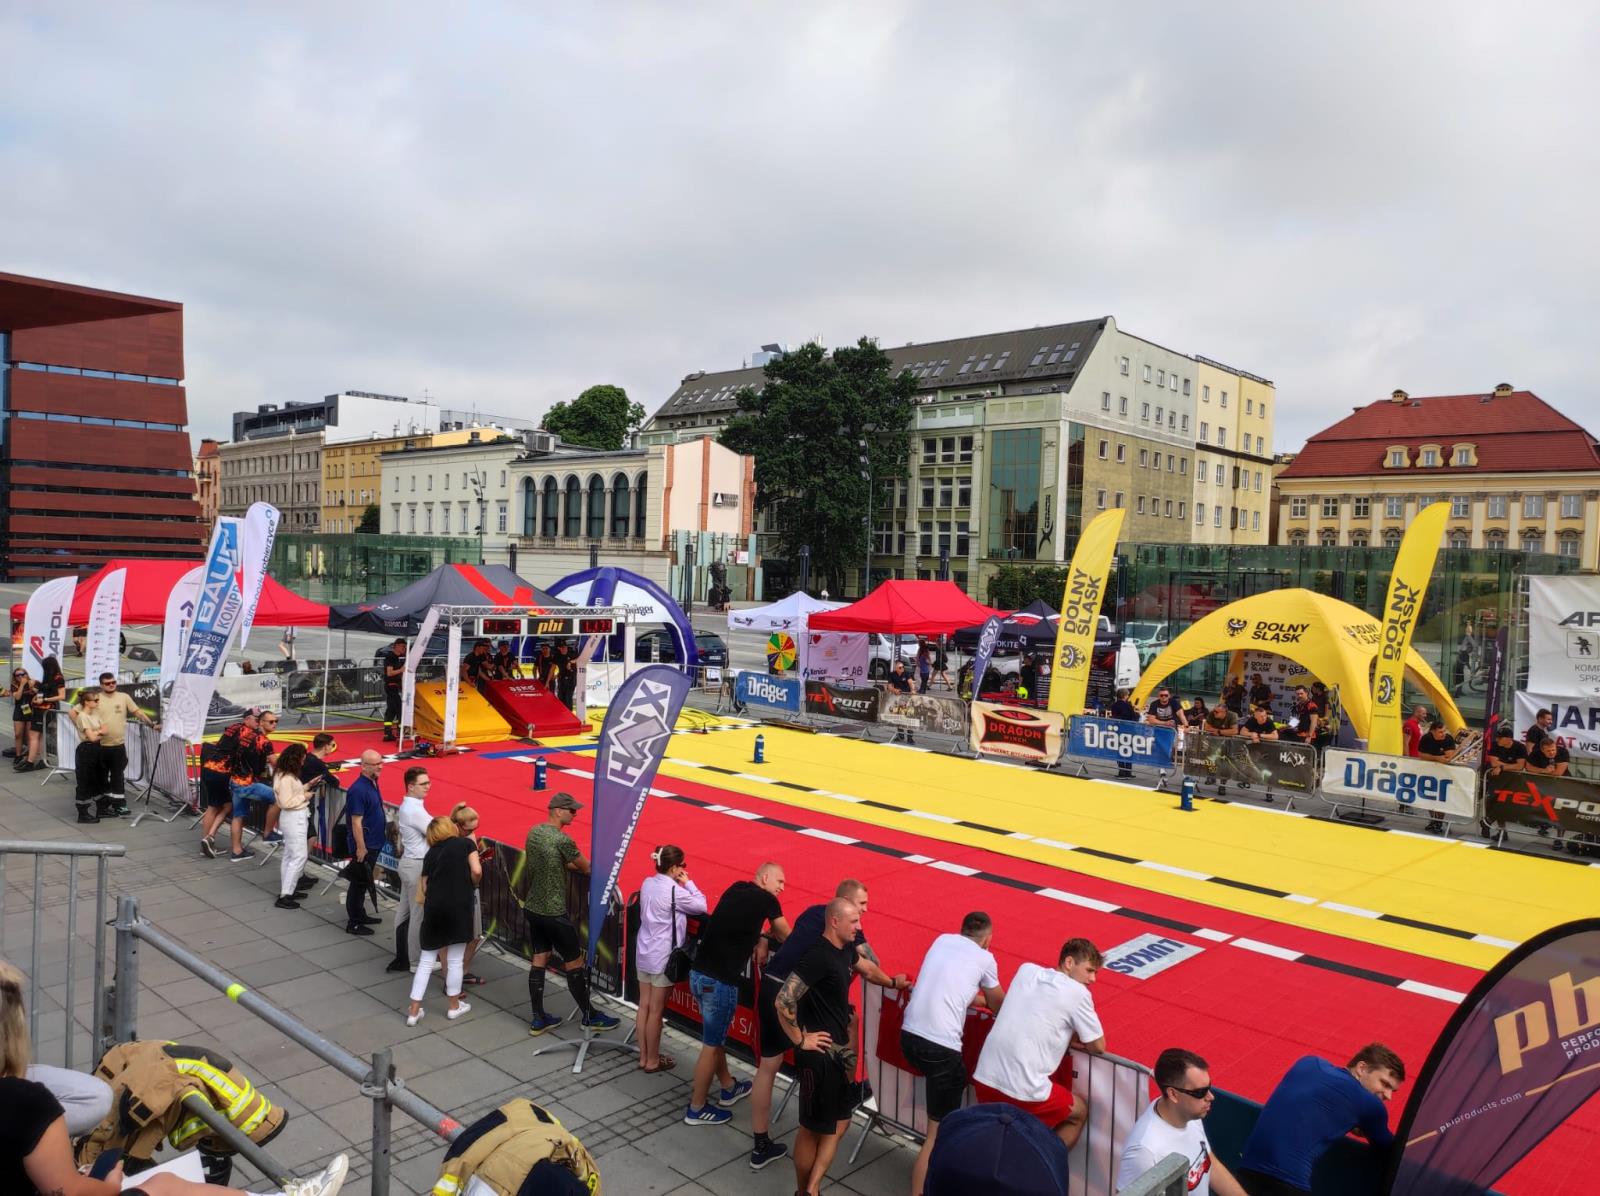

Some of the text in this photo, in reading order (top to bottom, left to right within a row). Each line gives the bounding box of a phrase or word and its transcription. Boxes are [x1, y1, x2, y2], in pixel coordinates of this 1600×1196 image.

[1063, 567, 1088, 634] DOLNY
[1382, 577, 1408, 660] DOLNY
[537, 619, 564, 635] pbi
[1256, 621, 1311, 633] DOLNY
[185, 644, 216, 671] 75
[747, 676, 789, 704] Dräger
[806, 687, 873, 714] TEXPORT
[989, 722, 1042, 739] DRAGON
[1083, 722, 1155, 758] Dräger
[1344, 757, 1453, 805] Dräger
[600, 787, 650, 906] www.haix.com
[1106, 938, 1187, 975] LUKAS
[1438, 1090, 1523, 1134] pbiproducts.com
